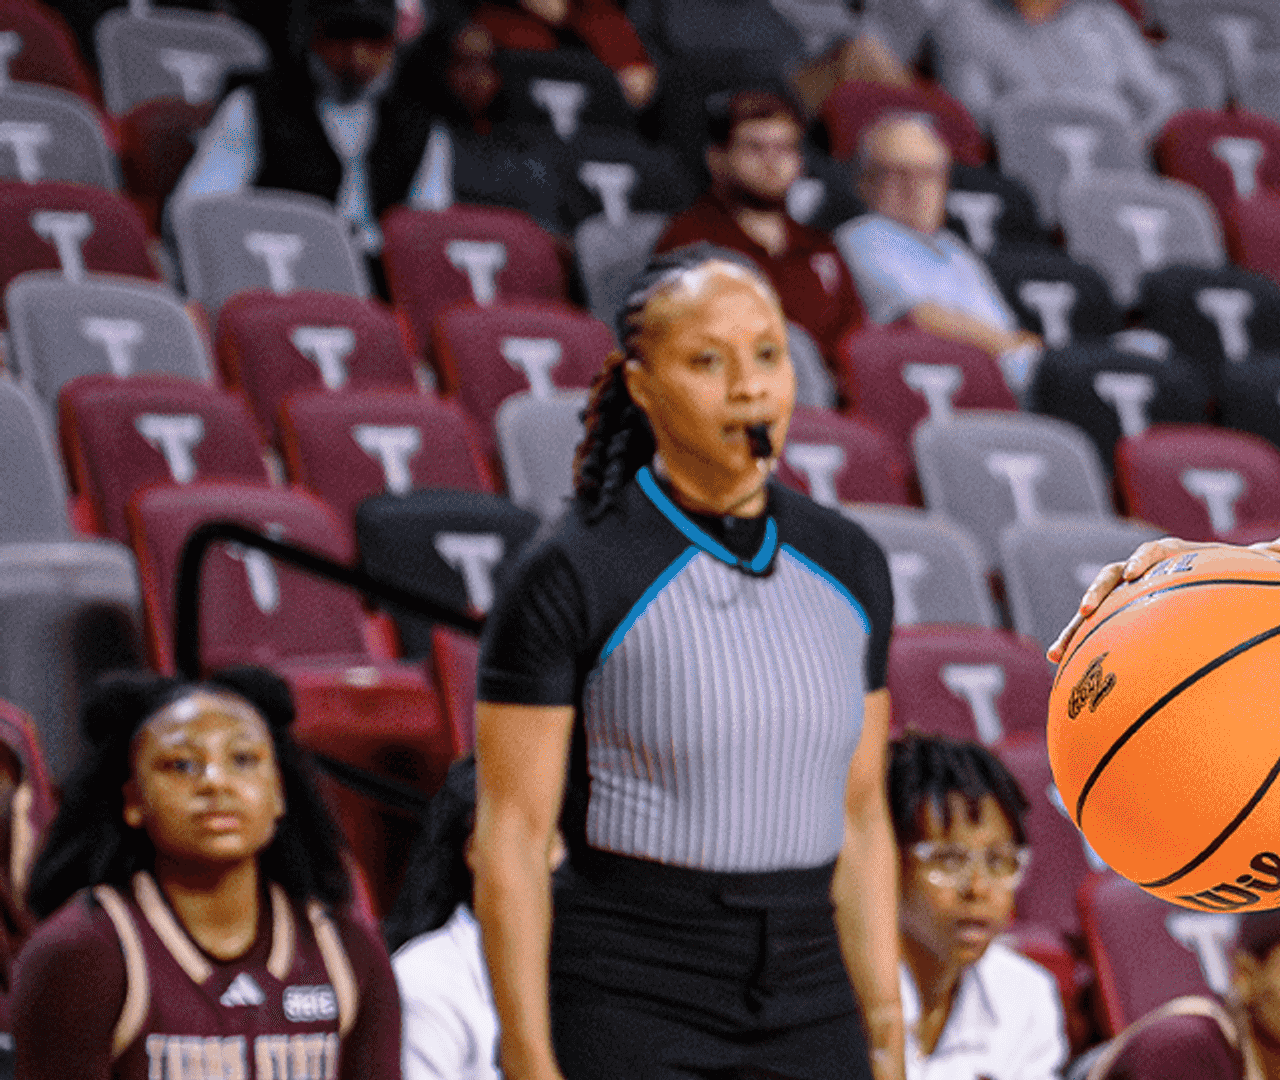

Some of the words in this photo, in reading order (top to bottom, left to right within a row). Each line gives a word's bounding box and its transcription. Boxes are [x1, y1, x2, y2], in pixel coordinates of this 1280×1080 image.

[530, 80, 584, 134] T
[578, 163, 633, 226] T
[1213, 138, 1263, 199] T
[32, 212, 92, 283] T
[244, 233, 300, 293] T
[1118, 207, 1169, 263] T
[447, 242, 505, 306] T
[1019, 281, 1076, 349] T
[1197, 289, 1250, 361] T
[82, 318, 141, 377] T
[293, 327, 354, 390] T
[502, 338, 561, 399] T
[904, 364, 962, 425] T
[1094, 373, 1155, 438] T
[136, 414, 203, 484] T
[353, 426, 421, 494] T
[788, 445, 843, 503] T
[987, 453, 1045, 523] T
[1182, 470, 1243, 532] T
[435, 533, 503, 612] T
[941, 664, 1004, 744] T
[1166, 913, 1240, 995] T
